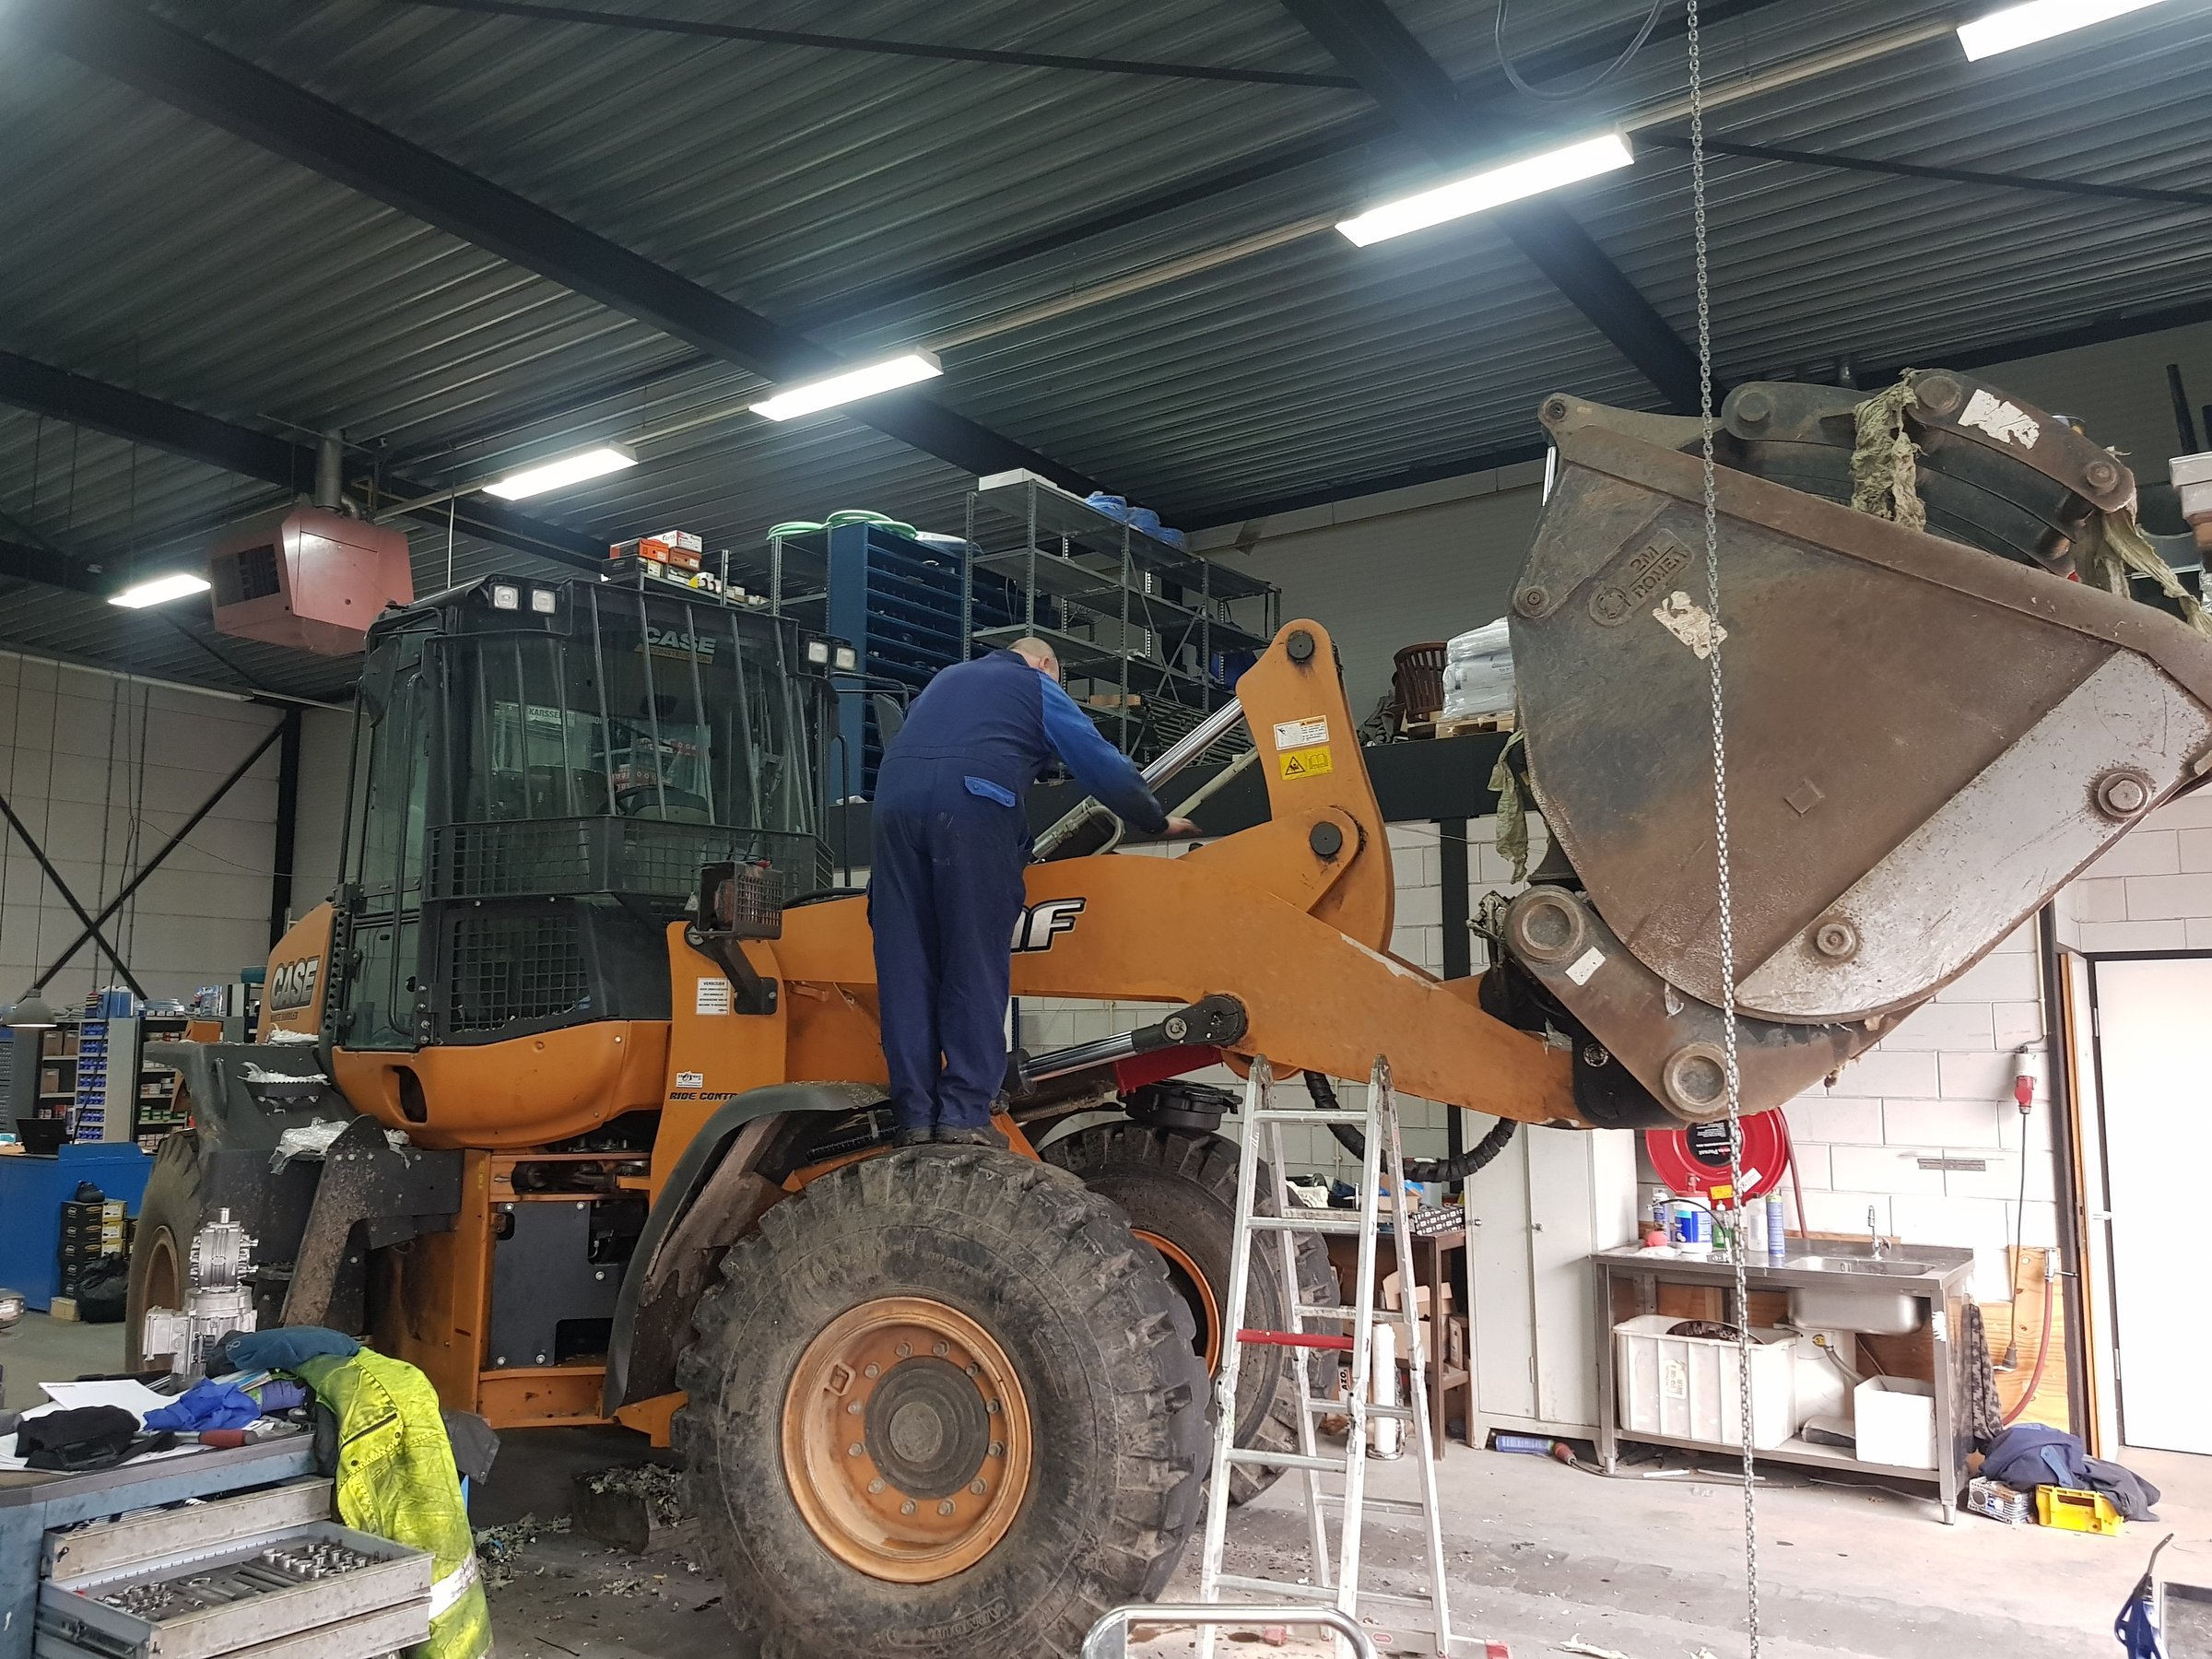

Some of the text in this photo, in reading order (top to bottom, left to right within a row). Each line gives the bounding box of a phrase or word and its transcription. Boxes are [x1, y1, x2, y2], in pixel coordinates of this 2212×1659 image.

[646, 626, 717, 655] CASE
[269, 955, 320, 1011] CASE
[669, 1092, 698, 1100] RIDE
